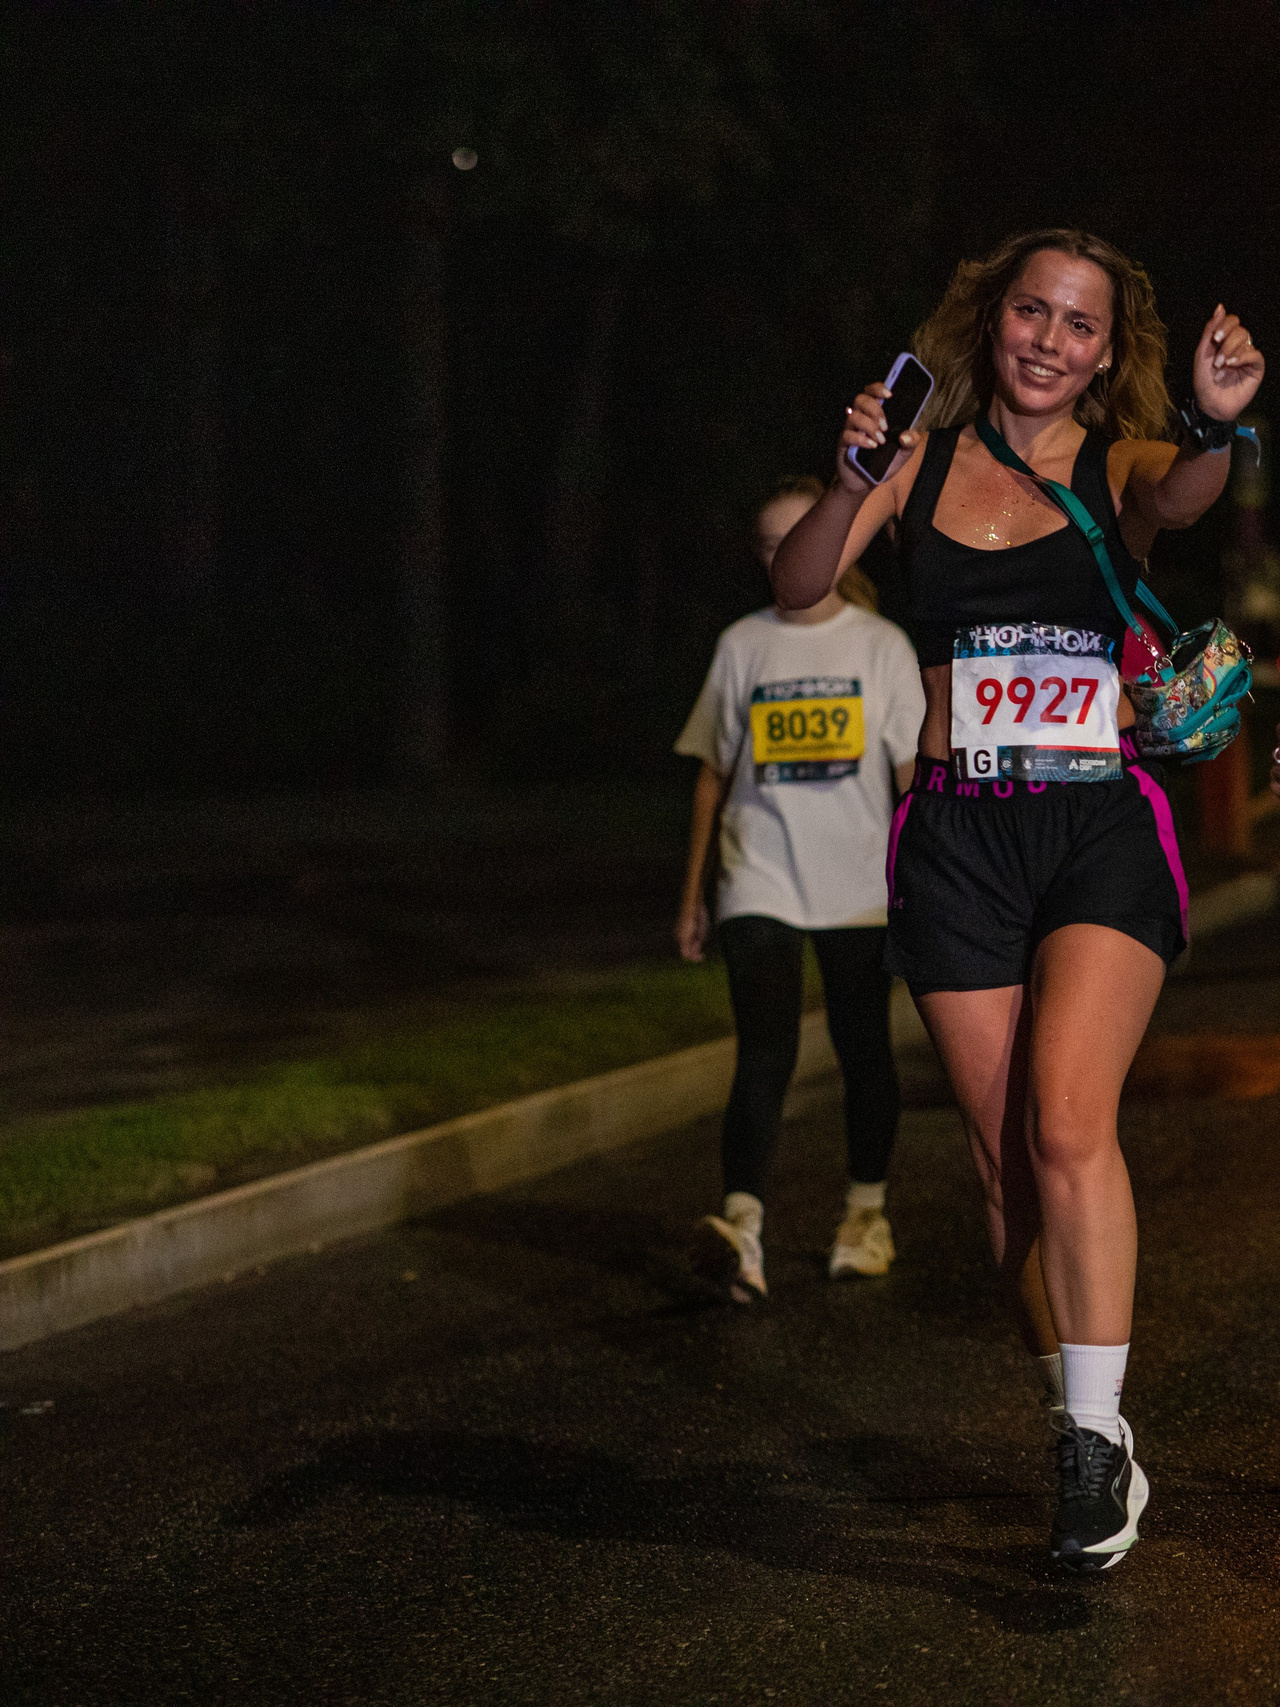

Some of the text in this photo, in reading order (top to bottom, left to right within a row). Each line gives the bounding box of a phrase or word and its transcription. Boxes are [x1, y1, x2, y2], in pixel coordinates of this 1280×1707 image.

[976, 676, 1099, 725] 9927
[766, 706, 850, 742] 8039
[973, 749, 992, 774] G
